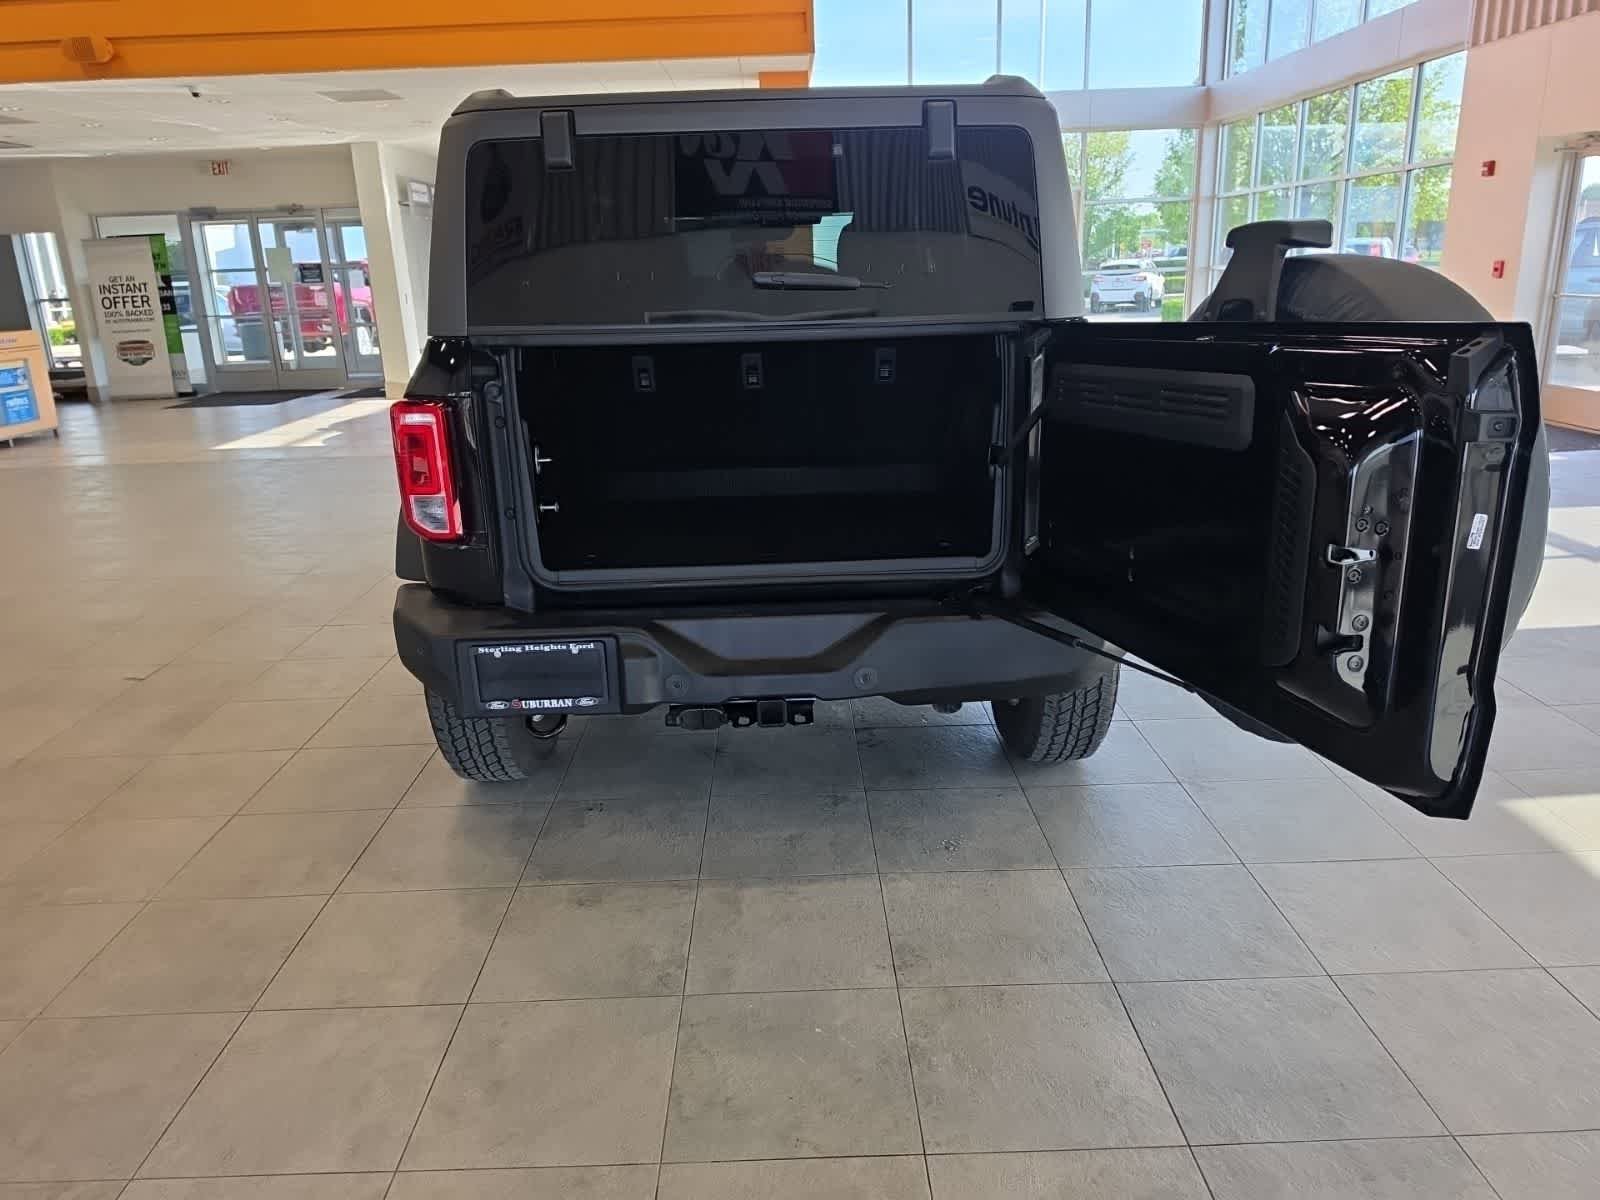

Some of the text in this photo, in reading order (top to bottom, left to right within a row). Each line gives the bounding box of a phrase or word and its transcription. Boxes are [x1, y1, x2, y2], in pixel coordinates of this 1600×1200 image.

[211, 160, 229, 176] EXIT
[98, 282, 149, 295] INSTANT
[101, 295, 152, 310] OFFER
[125, 309, 154, 318] BACKED
[478, 642, 595, 654] Sterling Heights Ford
[511, 698, 573, 709] SUBURBAN
